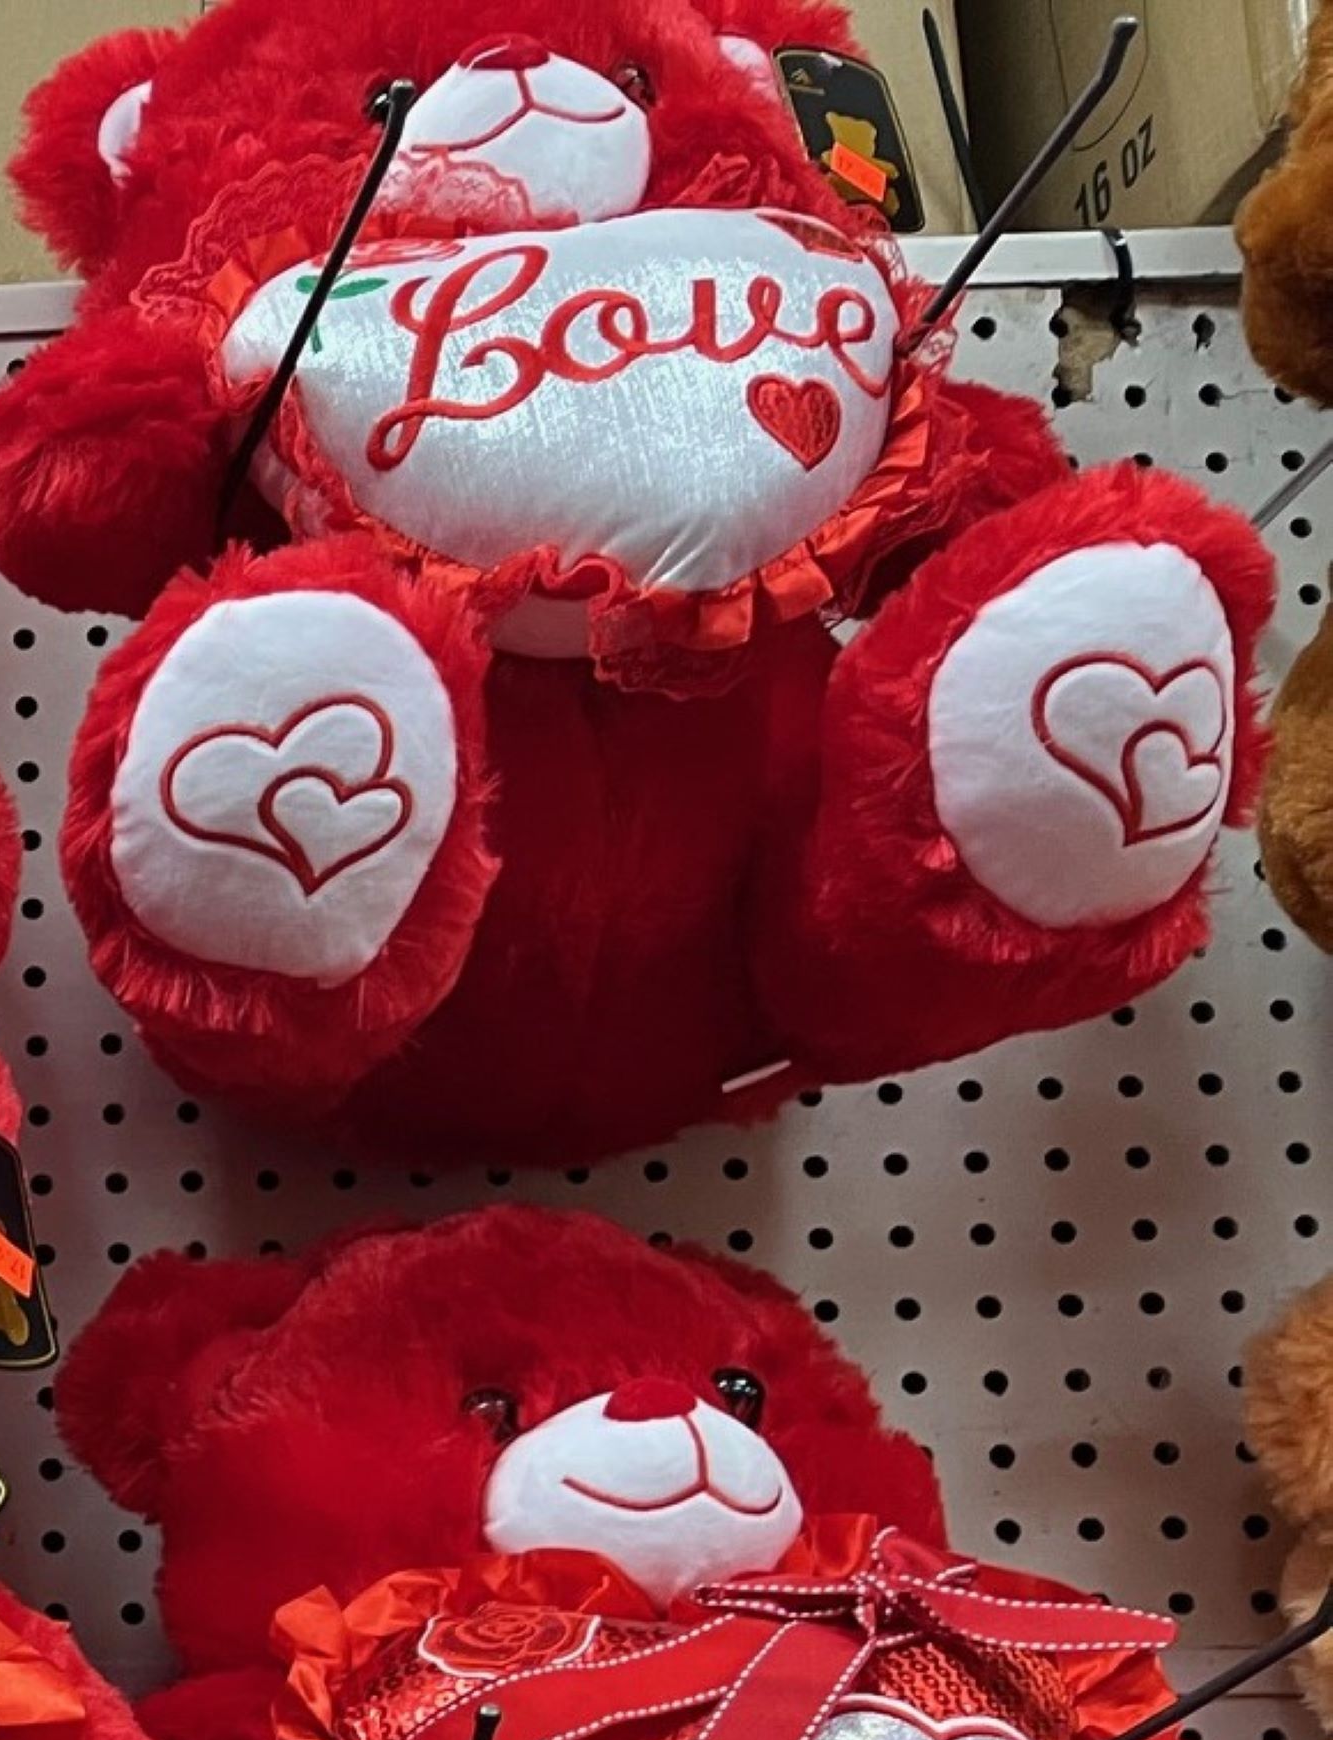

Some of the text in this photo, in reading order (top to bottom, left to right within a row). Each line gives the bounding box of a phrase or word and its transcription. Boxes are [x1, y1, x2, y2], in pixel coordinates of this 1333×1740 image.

[1075, 113, 1156, 227] 16 OZ
[366, 244, 887, 471] Love
